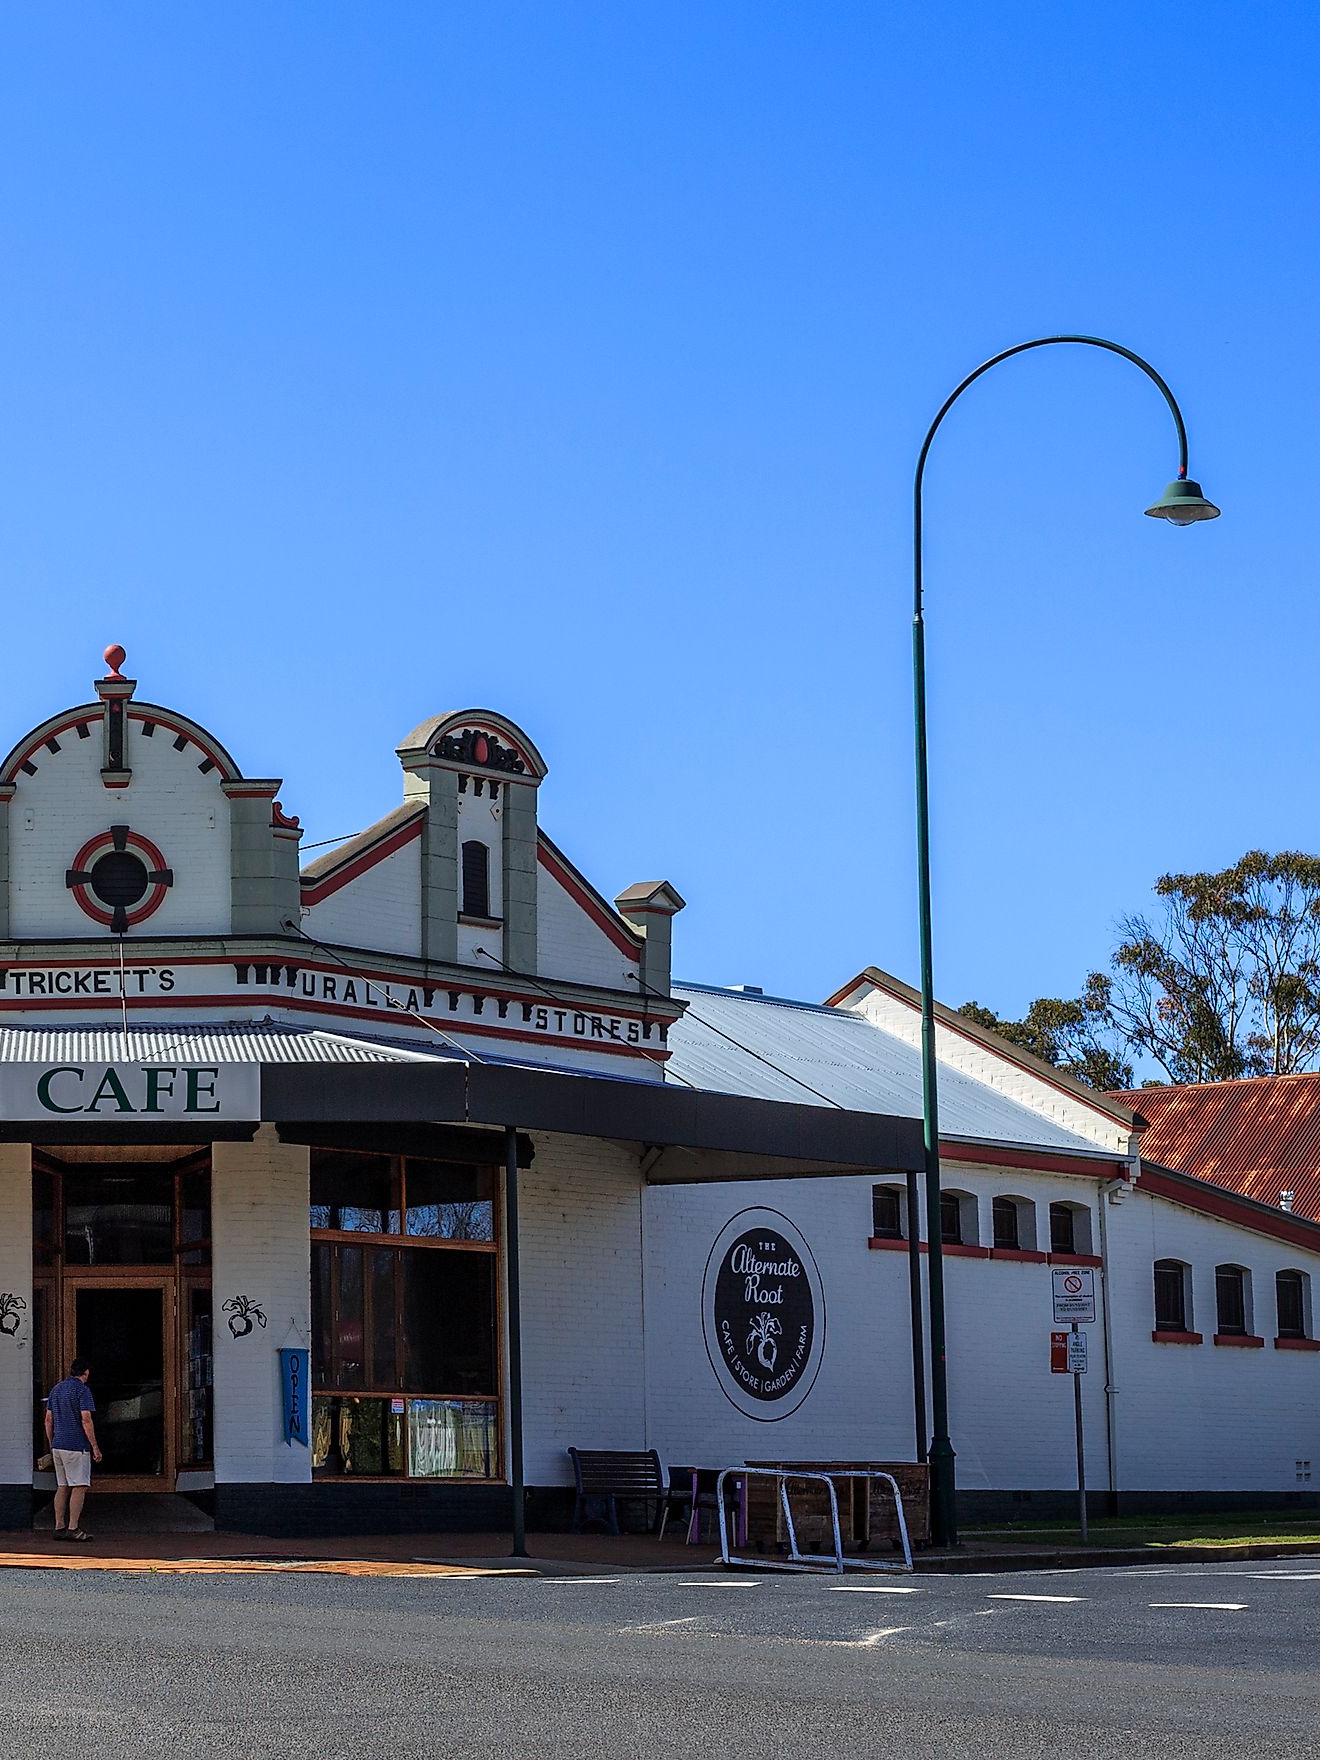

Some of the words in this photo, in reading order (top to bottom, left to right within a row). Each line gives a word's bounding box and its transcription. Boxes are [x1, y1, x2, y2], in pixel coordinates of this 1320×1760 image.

[10, 968, 175, 994] TRICKETT'S
[303, 973, 419, 1012] URALLA
[536, 1004, 640, 1042] STORES
[37, 1066, 220, 1114] CAFE
[731, 1243, 801, 1277] Alternate
[759, 1242, 776, 1251] THE
[744, 1273, 784, 1304] Root
[721, 1320, 735, 1356] CAFE
[734, 1360, 759, 1390] STORE
[764, 1364, 796, 1393] GARDEN
[795, 1325, 808, 1360] FARM
[289, 1354, 301, 1434] OPEN
